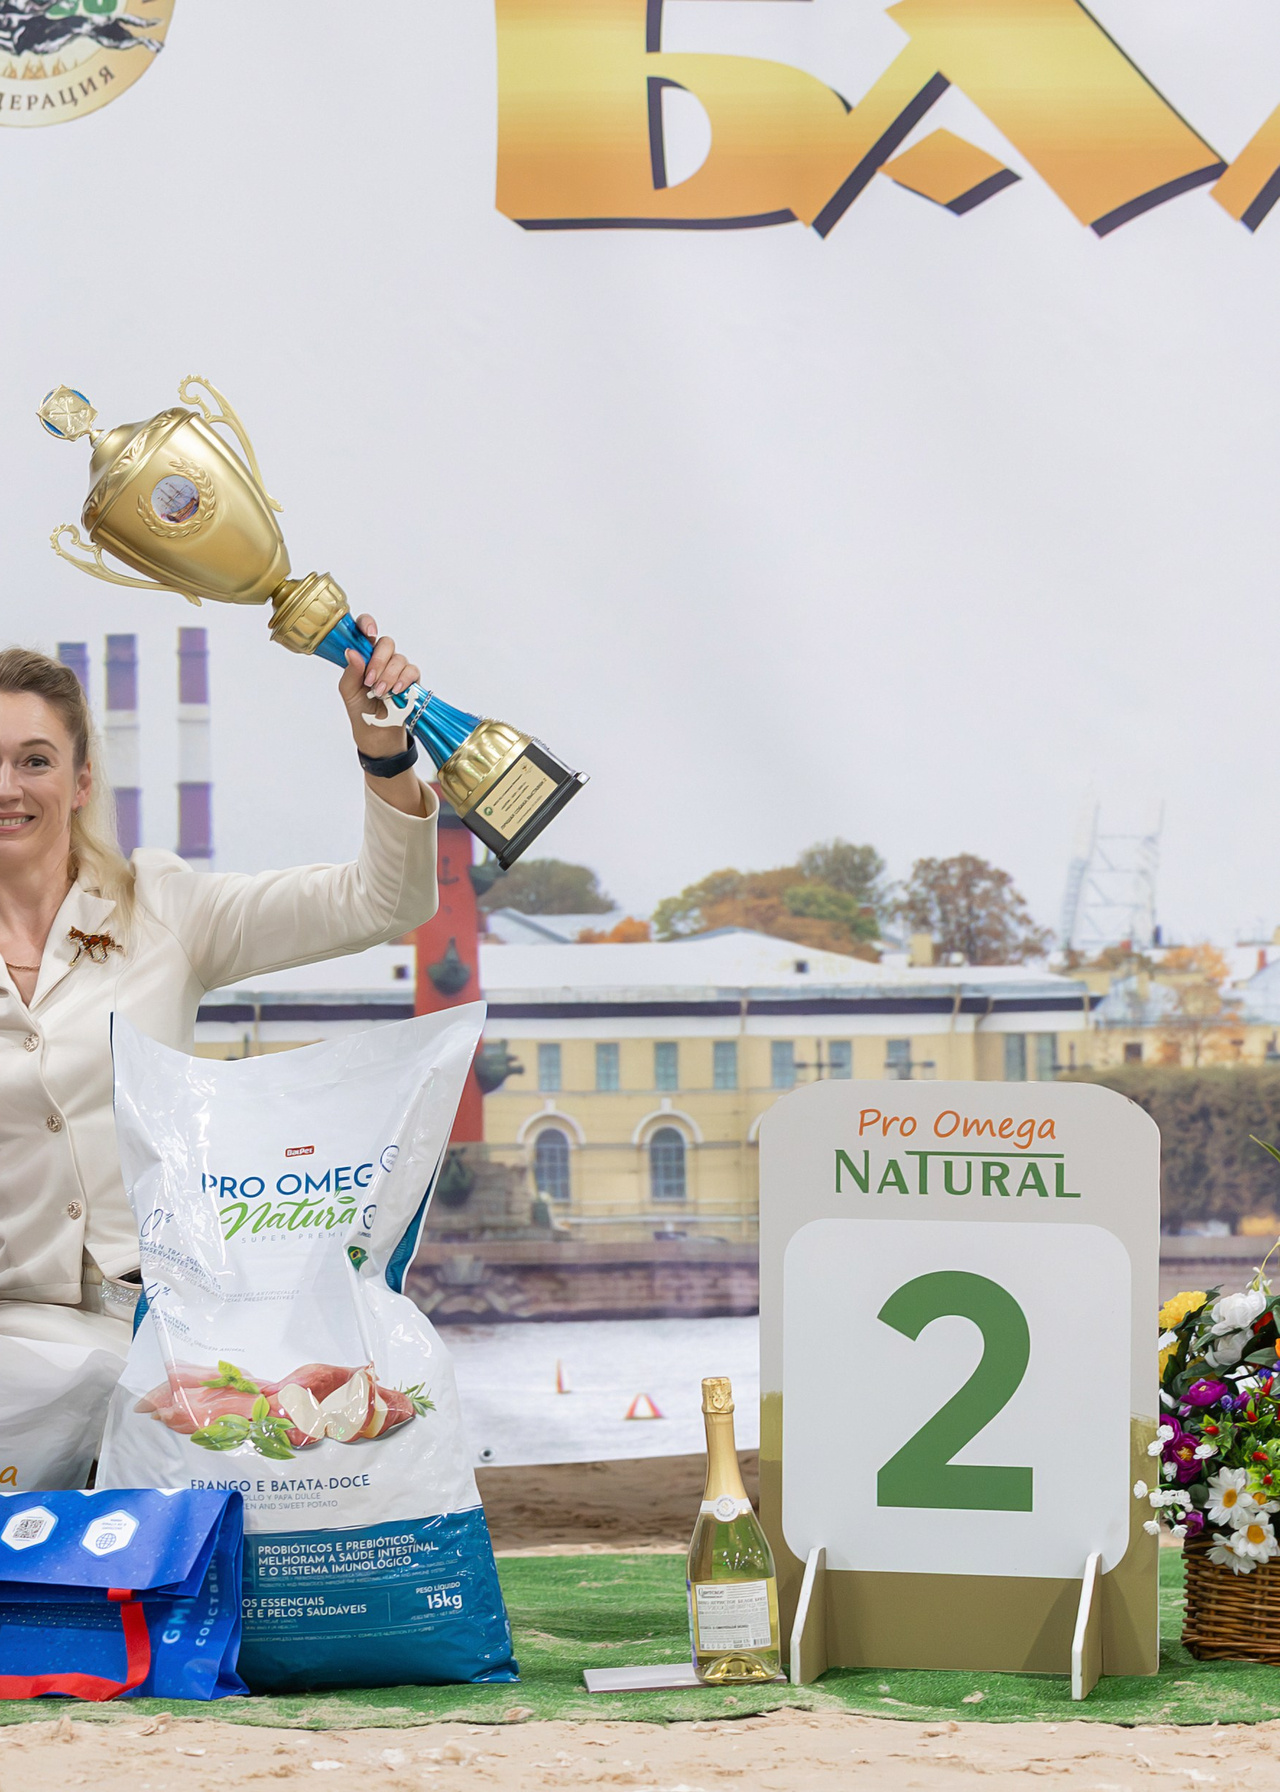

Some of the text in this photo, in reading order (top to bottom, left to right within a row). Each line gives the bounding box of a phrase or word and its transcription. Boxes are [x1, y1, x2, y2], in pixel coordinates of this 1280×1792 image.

[858, 1108, 1056, 1149] Pro Omega
[201, 1172, 266, 1199] PRO
[241, 1233, 287, 1244] SUPER
[876, 1270, 1034, 1512] 2
[191, 1474, 371, 1492] FRANGO E BATATA-DOCE
[295, 1491, 321, 1500] DULCE
[259, 1502, 277, 1510] AND
[307, 1500, 338, 1508] POTATO
[258, 1533, 416, 1555] PROBIÓTICOS E PREBIÓTICOS
[258, 1555, 325, 1566] MELHORAM
[328, 1554, 336, 1563] A
[338, 1549, 375, 1562] SAÚDE
[258, 1567, 266, 1576] E
[269, 1566, 279, 1576] O
[281, 1563, 329, 1576] SISTEMA
[331, 1555, 412, 1574] IMUNOLÓGICO
[415, 1581, 461, 1594] PESO LÍQUIDO
[241, 1596, 325, 1607] OS ESSENCIAIS
[426, 1589, 463, 1610] 15kg
[257, 1609, 264, 1618] E
[268, 1607, 304, 1617] PELOS
[307, 1603, 367, 1616] SAUDÁVEIS
